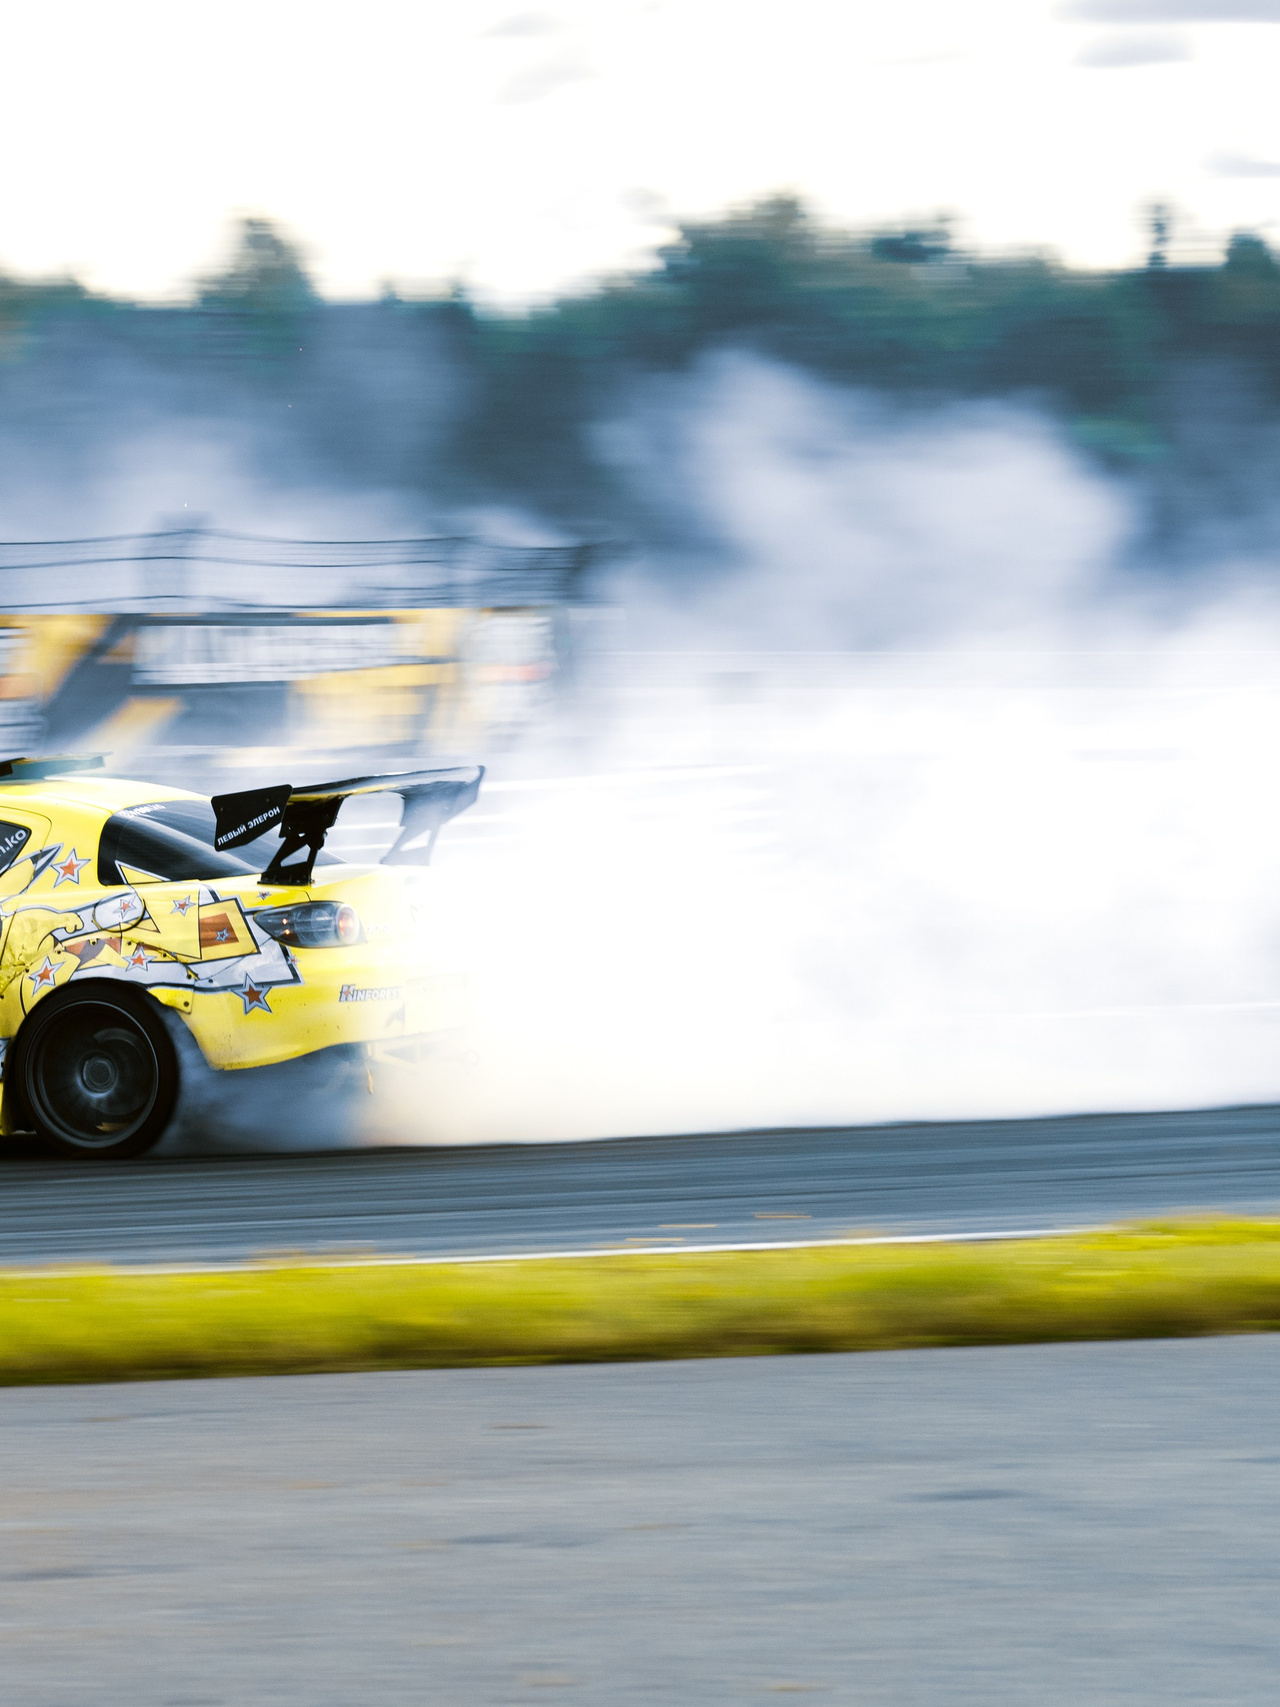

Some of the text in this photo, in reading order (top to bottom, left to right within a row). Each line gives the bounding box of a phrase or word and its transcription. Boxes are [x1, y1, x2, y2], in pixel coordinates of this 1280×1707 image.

[217, 806, 281, 846] ЛЕВЫЙ ЭЛЕРОН
[339, 984, 404, 1002] KINFOREST
